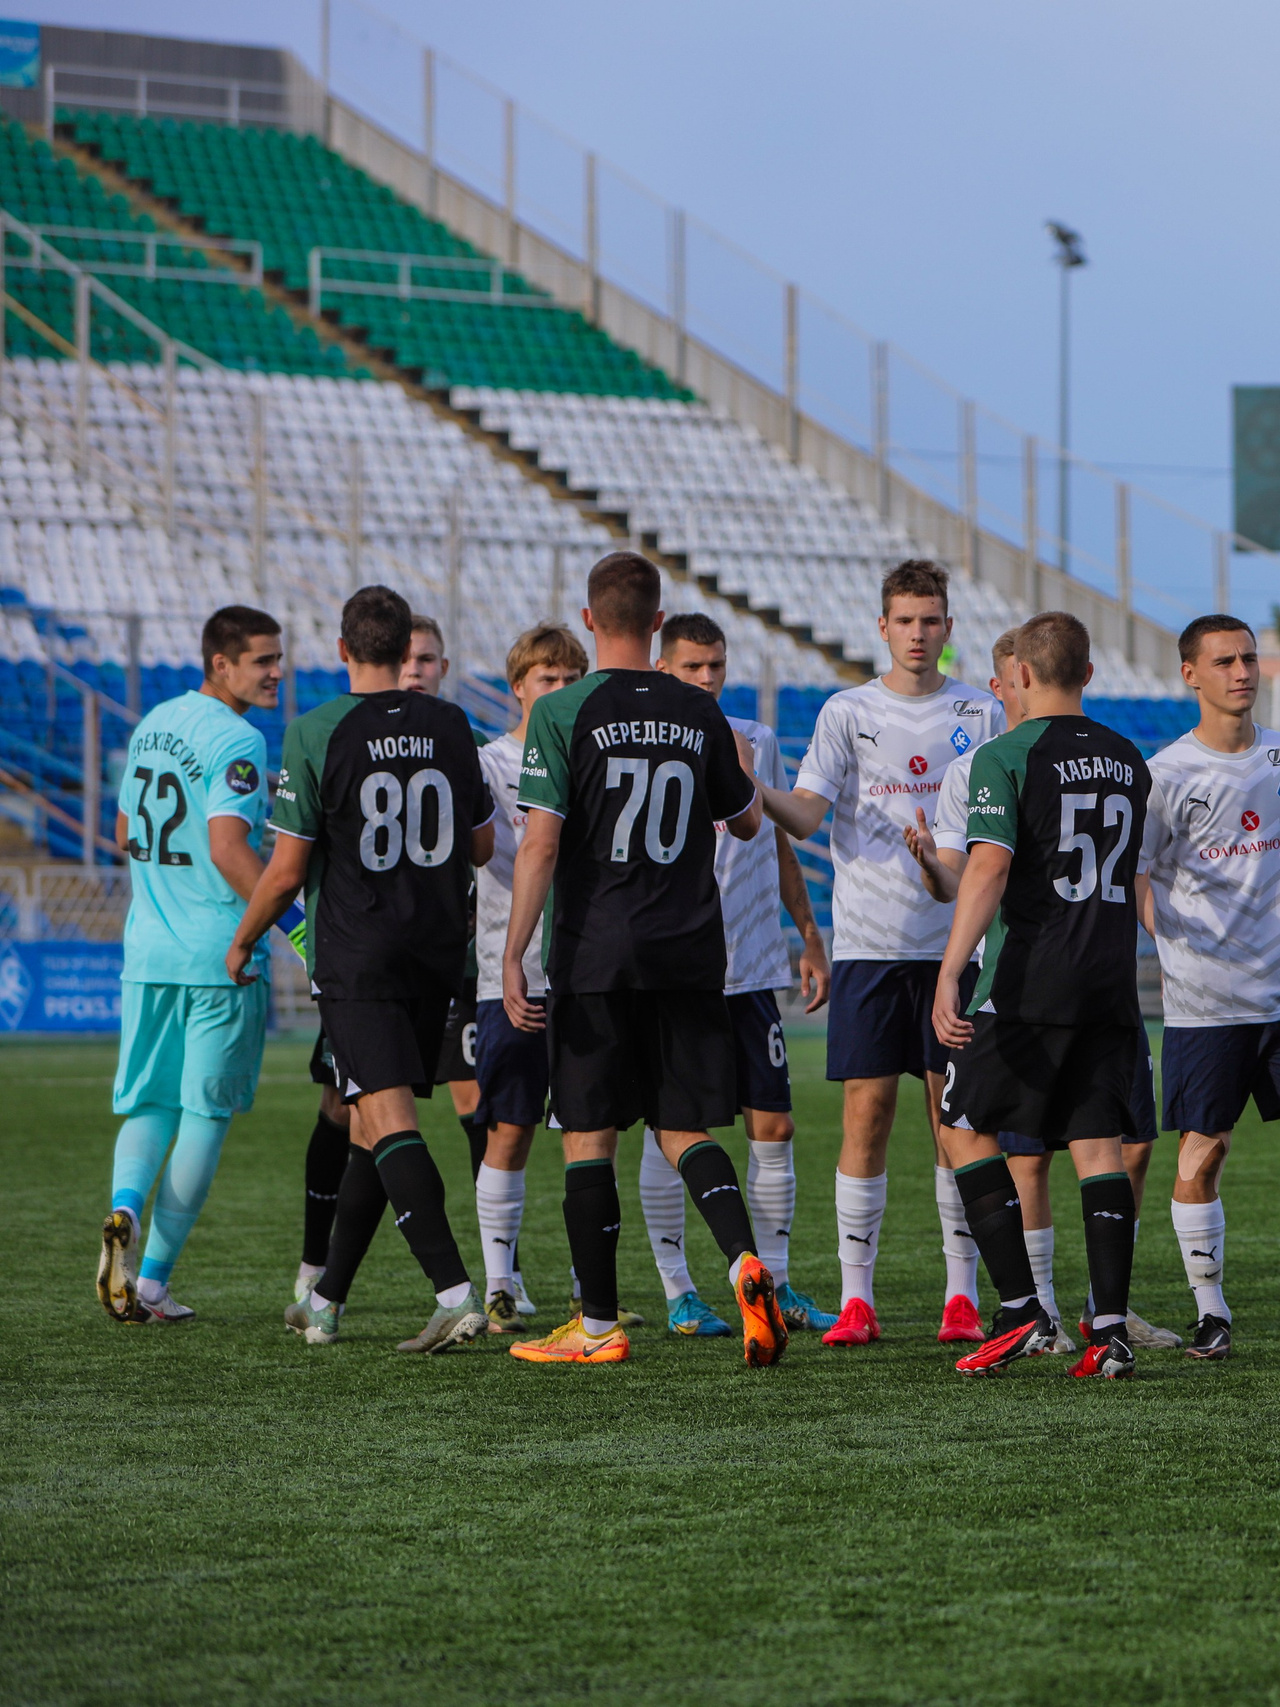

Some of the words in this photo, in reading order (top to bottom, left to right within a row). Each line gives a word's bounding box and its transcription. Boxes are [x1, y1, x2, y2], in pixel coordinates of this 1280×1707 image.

[367, 735, 434, 762] МОСИН
[591, 720, 705, 755] ПЕРЕДЕРИЙ
[1053, 756, 1133, 787] ХАБАРОВ
[128, 766, 193, 866] 32
[360, 768, 455, 872] 80
[605, 757, 694, 864] 70
[1052, 793, 1133, 904] 52
[767, 1020, 788, 1068] 6
